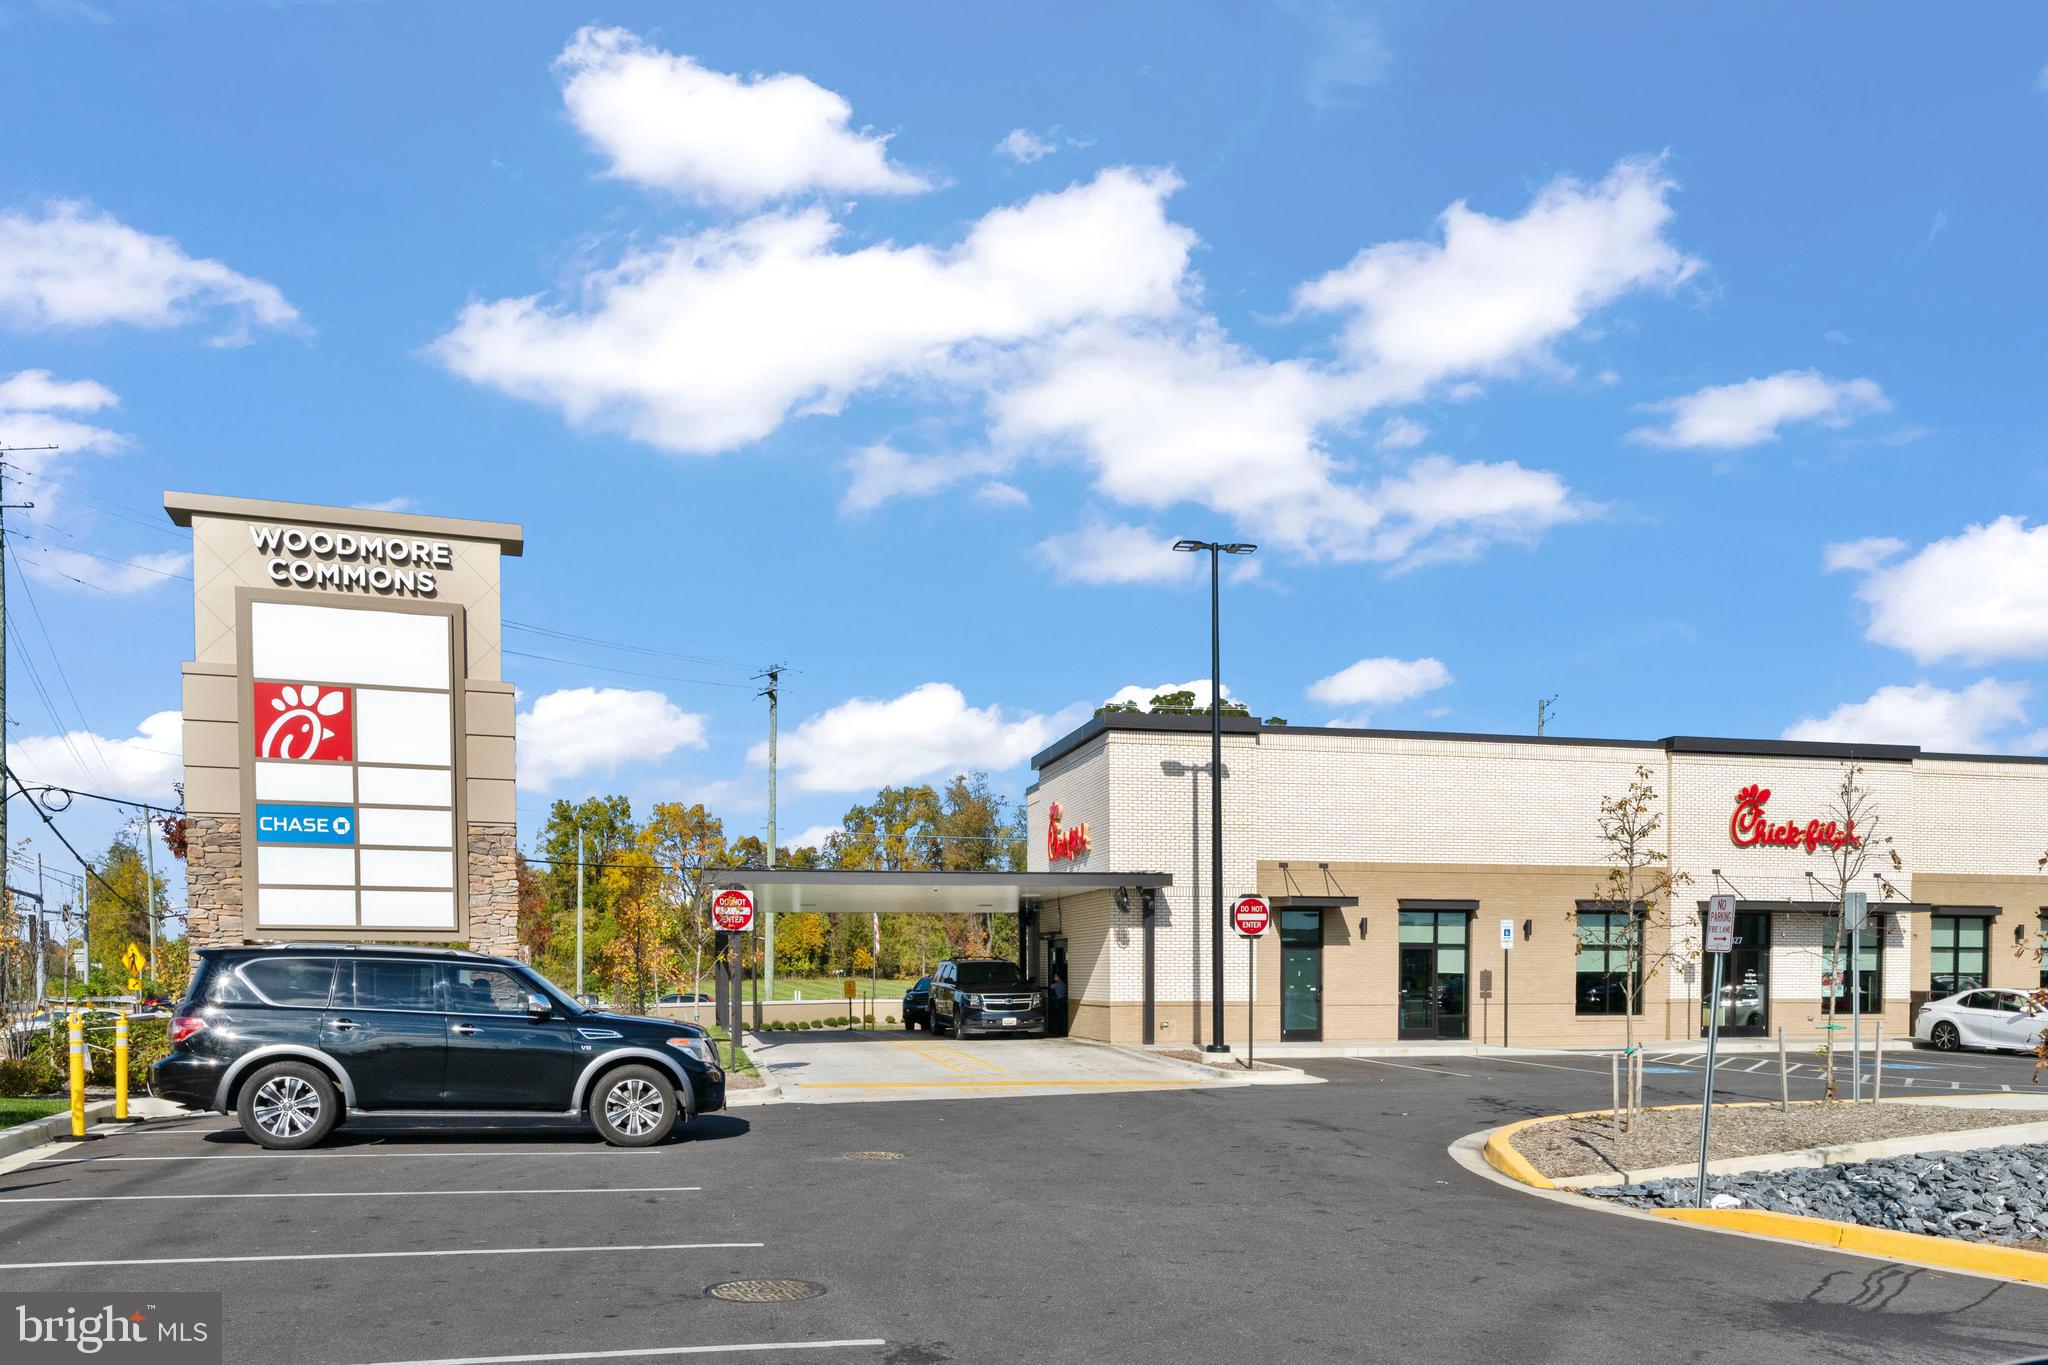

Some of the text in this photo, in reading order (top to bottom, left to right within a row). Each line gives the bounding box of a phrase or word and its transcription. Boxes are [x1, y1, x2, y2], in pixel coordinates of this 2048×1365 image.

[249, 525, 451, 564] WOODMORE
[267, 558, 435, 592] COMMONS
[1730, 784, 1863, 853] Chick-fil-A
[260, 816, 329, 833] CHASE
[732, 898, 747, 906] NOT
[1718, 900, 1727, 910] NO
[721, 915, 744, 924] ENTER
[1711, 912, 1732, 922] PARKING
[1709, 925, 1731, 934] FIRE LANE
